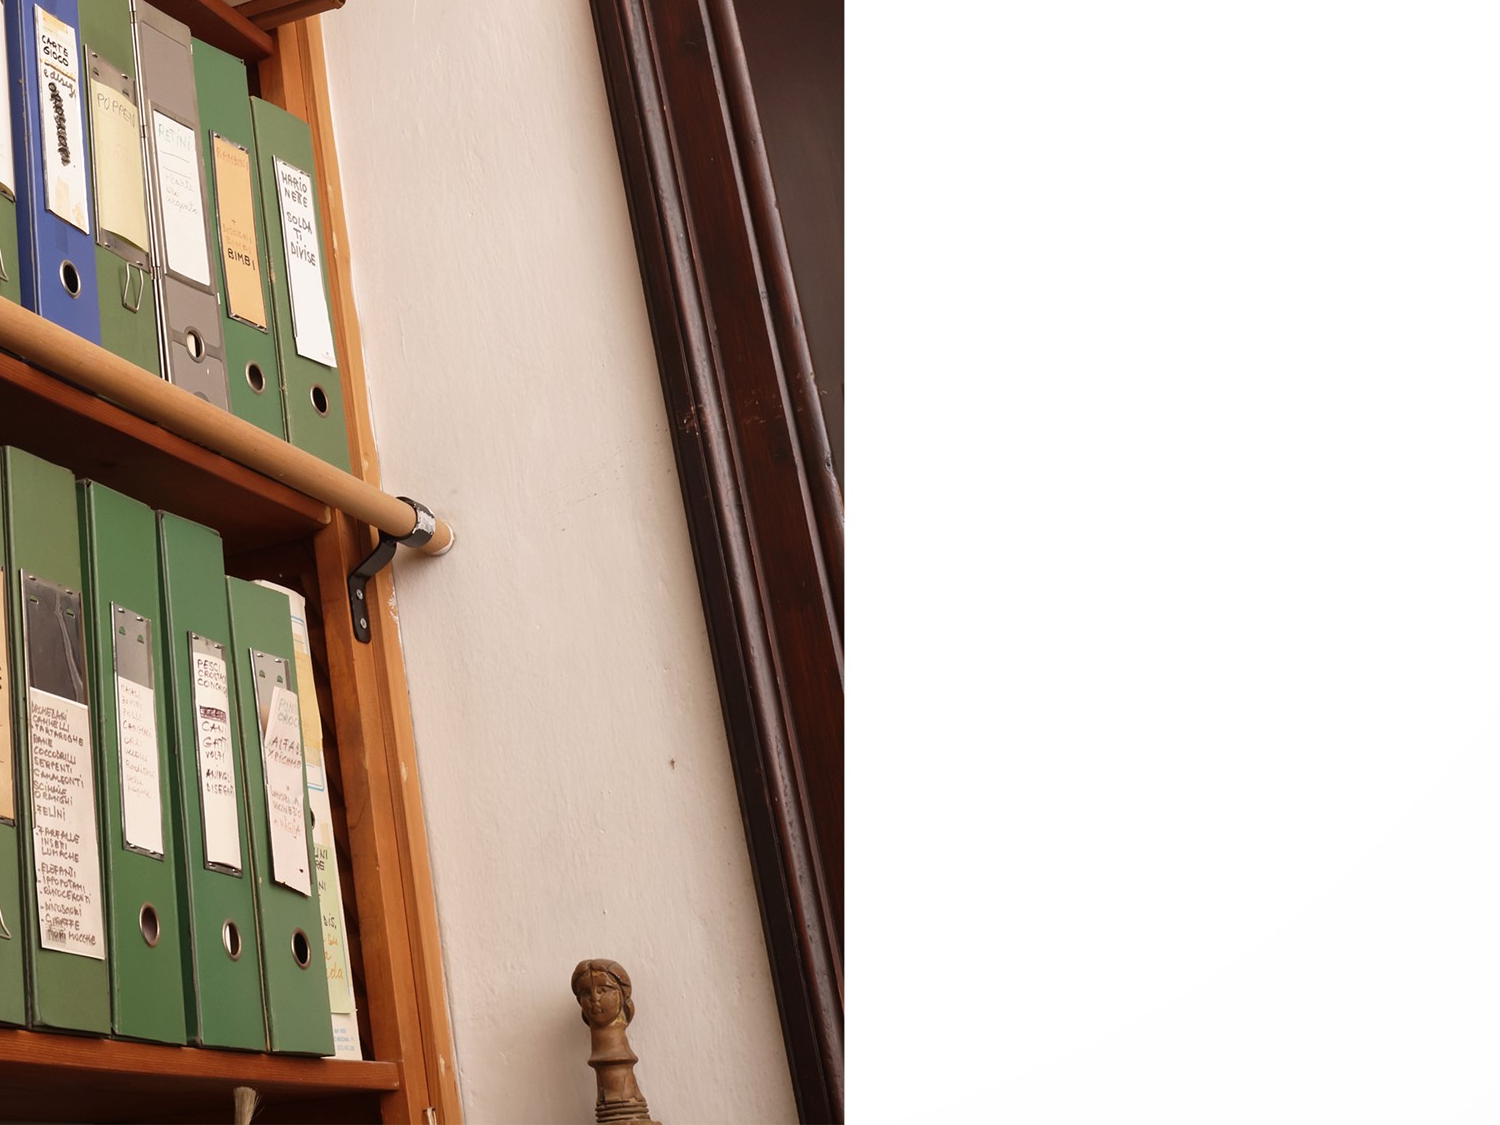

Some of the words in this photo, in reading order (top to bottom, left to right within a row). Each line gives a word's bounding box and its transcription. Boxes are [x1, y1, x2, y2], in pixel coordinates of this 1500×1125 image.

[43, 46, 69, 67] GIOCO
[227, 248, 256, 271] BIMBI
[33, 756, 72, 774] SERPENTI
